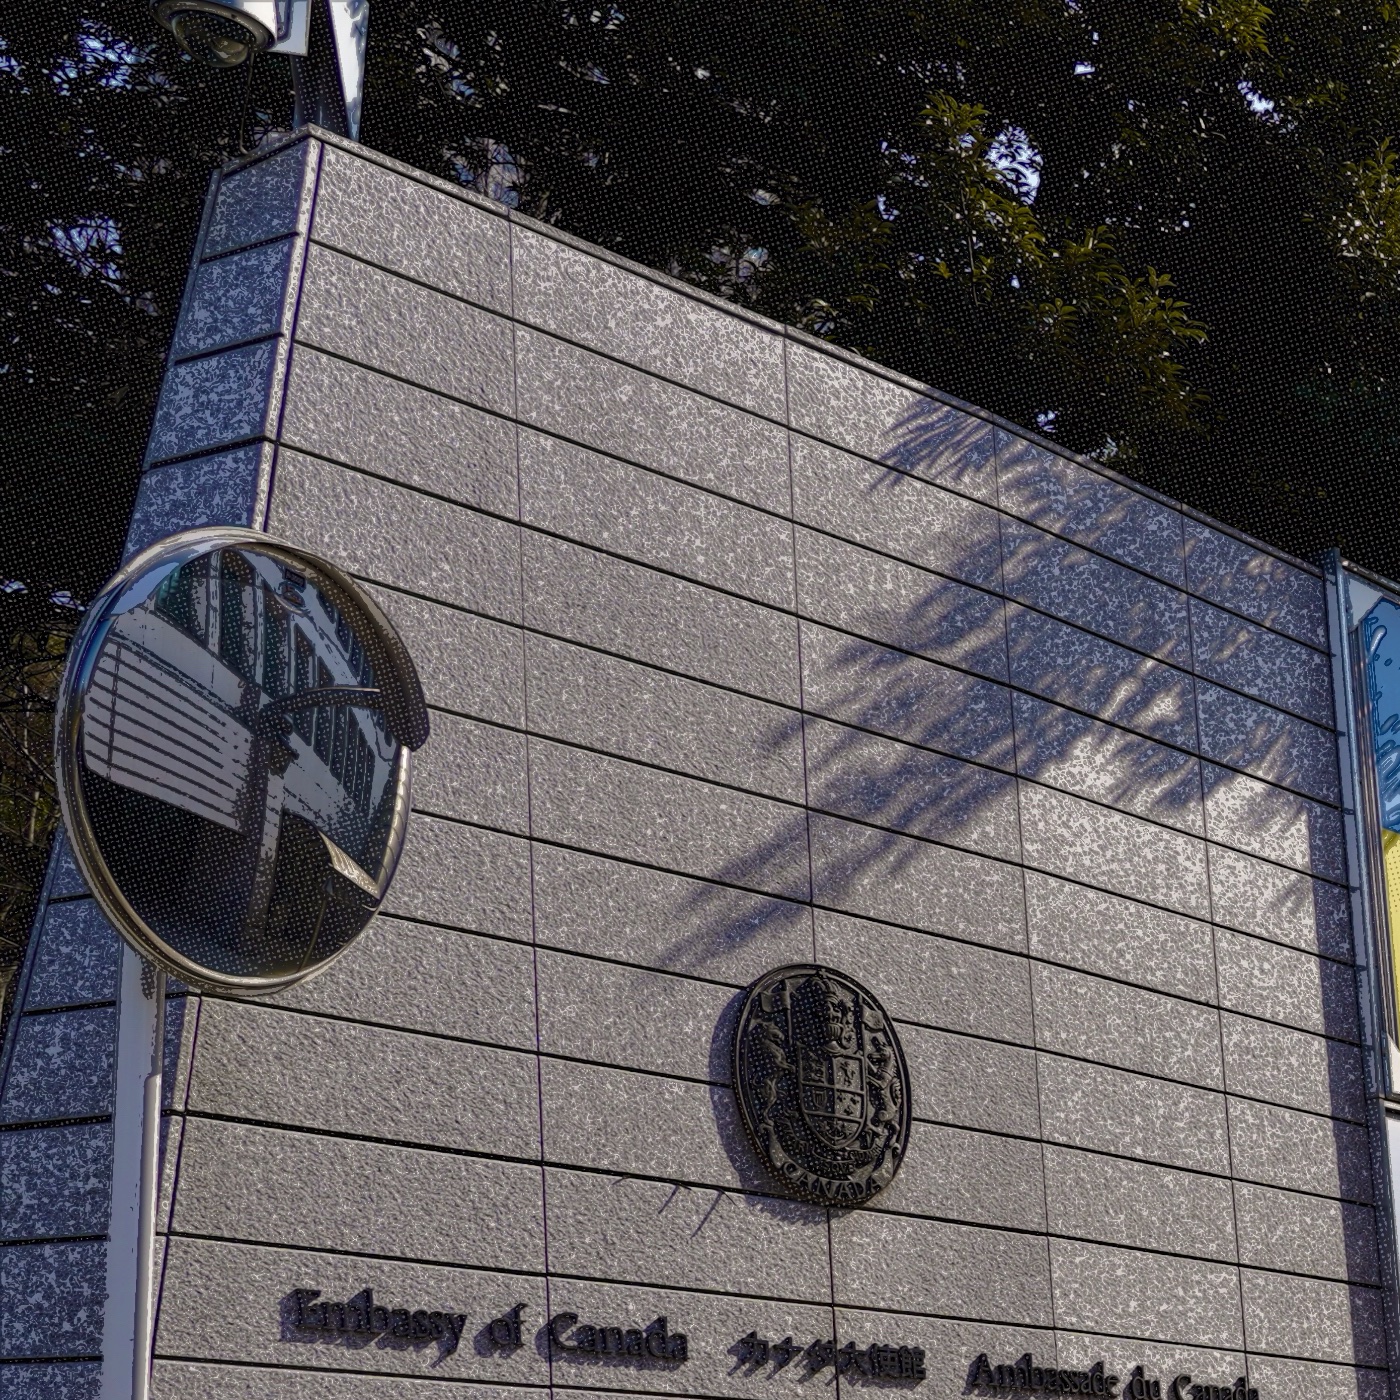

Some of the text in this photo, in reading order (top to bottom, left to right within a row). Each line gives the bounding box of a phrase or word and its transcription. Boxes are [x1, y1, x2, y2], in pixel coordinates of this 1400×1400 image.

[783, 1161, 883, 1200] CANADA
[292, 1288, 689, 1363] Embassy of Canada
[734, 1331, 927, 1381] カナダ大使館
[971, 1353, 1120, 1397] Ambassade
